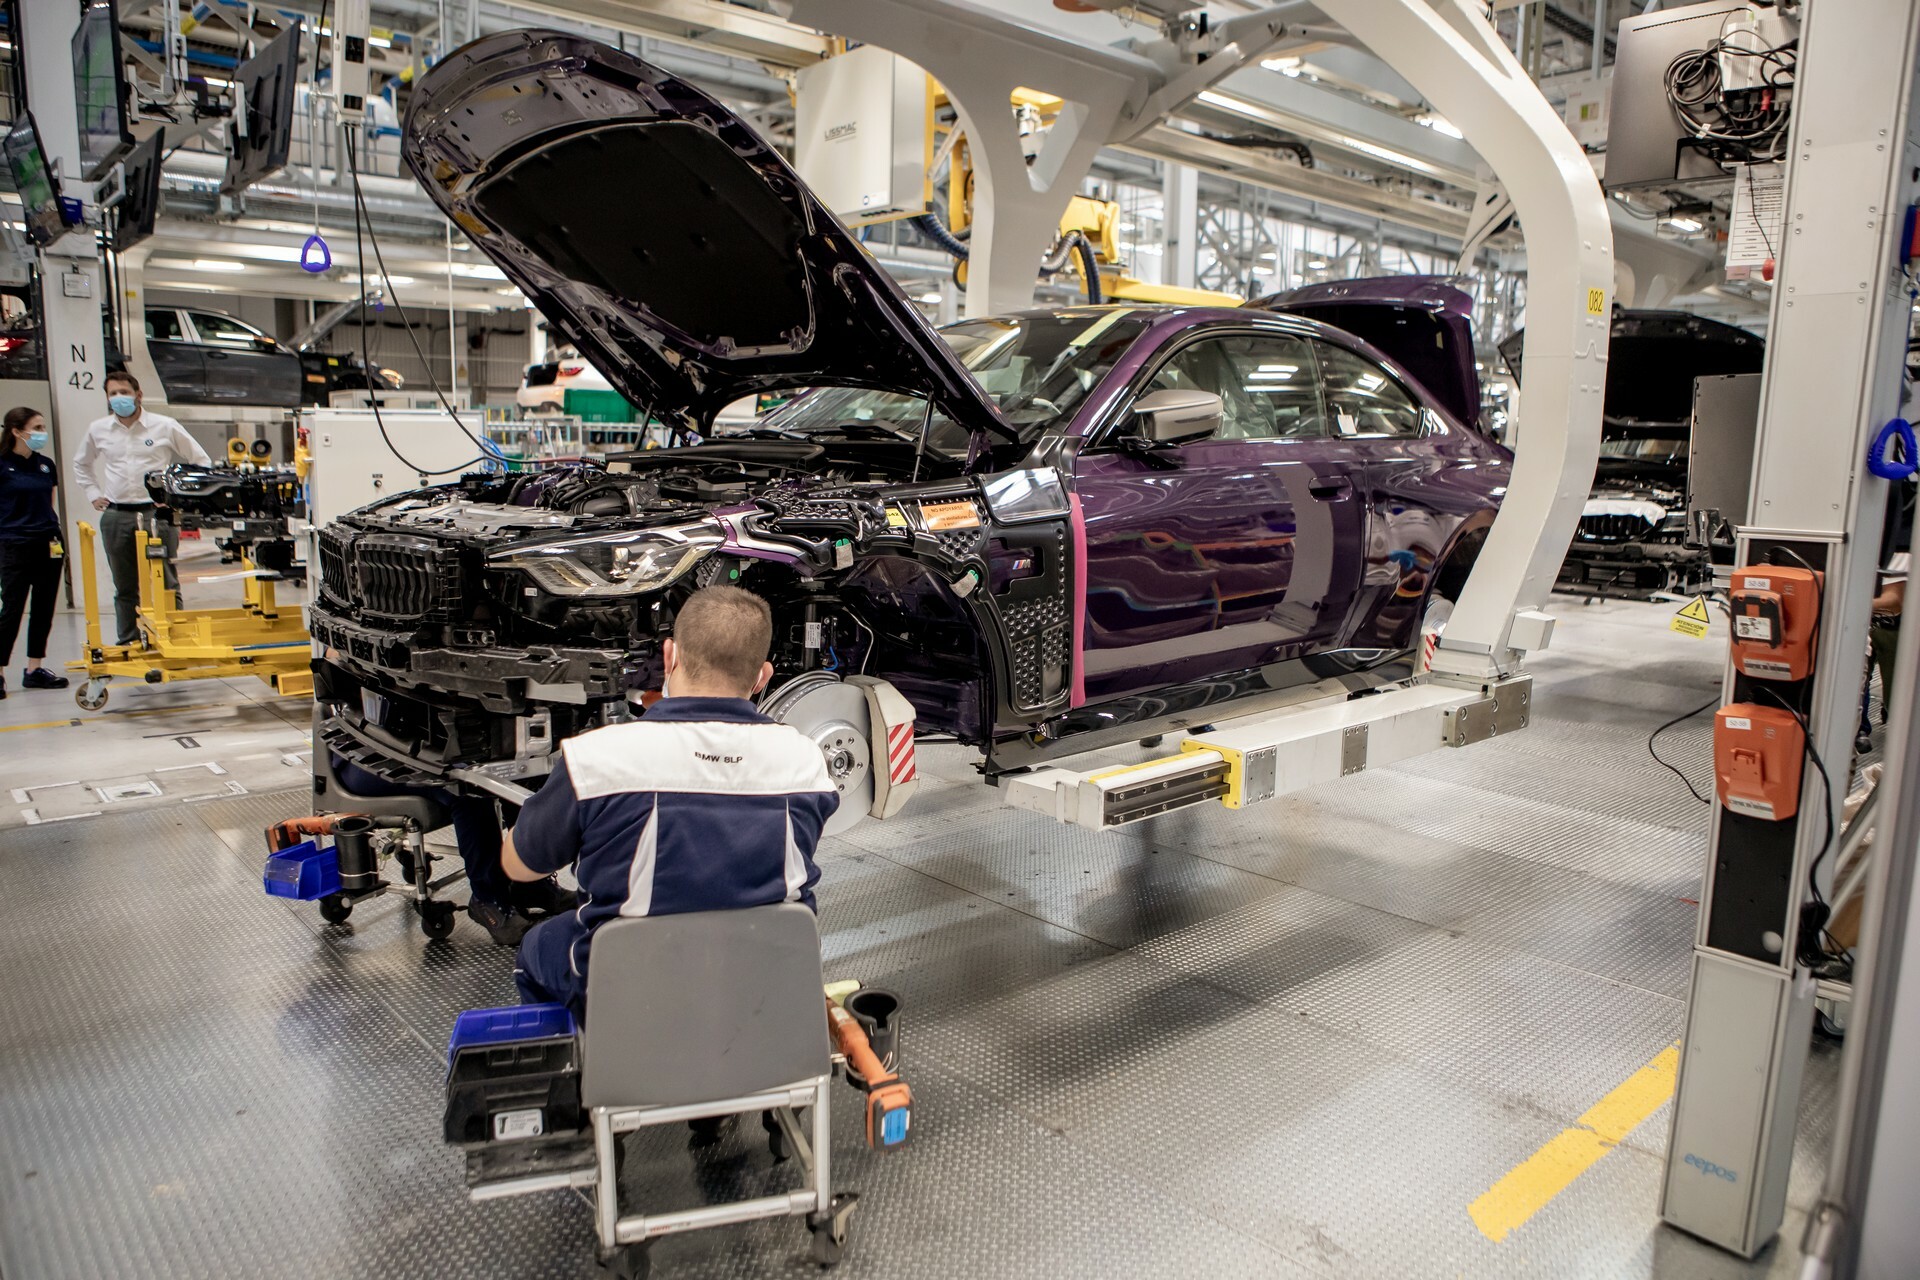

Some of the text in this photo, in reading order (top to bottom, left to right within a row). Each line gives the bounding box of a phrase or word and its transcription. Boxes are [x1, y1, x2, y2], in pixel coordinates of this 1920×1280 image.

[824, 121, 857, 140] LISSMAC
[1588, 290, 1604, 312] 082
[71, 344, 86, 363] N
[69, 371, 94, 390] 42
[694, 751, 720, 763] BMW
[1684, 1153, 1737, 1183] eepos
